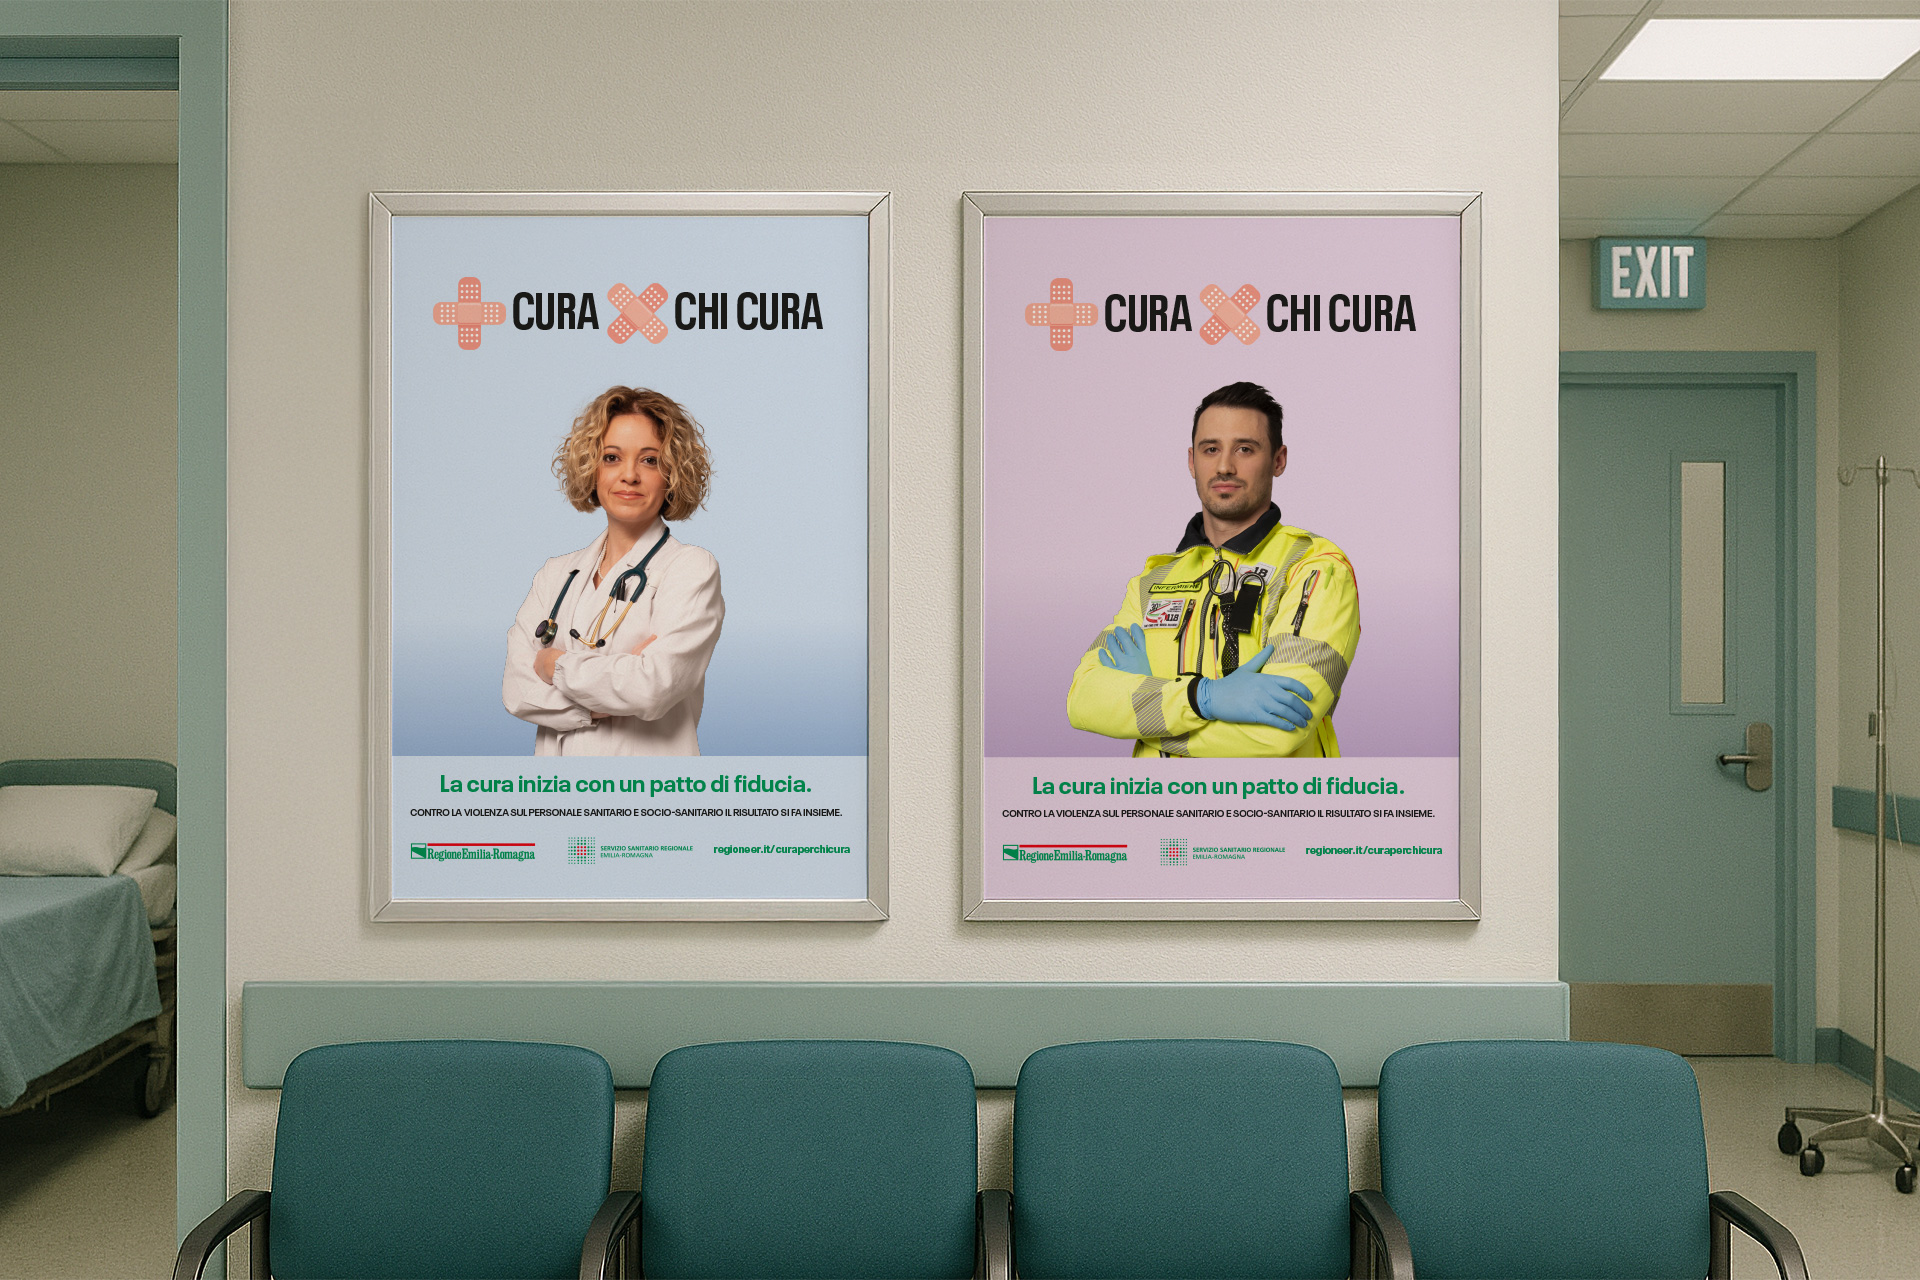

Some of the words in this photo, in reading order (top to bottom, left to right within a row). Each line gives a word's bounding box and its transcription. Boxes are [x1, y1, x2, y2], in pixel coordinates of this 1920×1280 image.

[1611, 245, 1695, 298] EXIT
[513, 292, 599, 330] CURA
[675, 292, 728, 330] CHI
[737, 292, 823, 330] CURA
[1105, 294, 1192, 332] CURA
[1267, 294, 1320, 332] CHI
[1329, 294, 1416, 332] CURA
[441, 775, 462, 792] La
[467, 779, 513, 793] cura
[519, 774, 571, 792] inizia
[576, 779, 615, 793] con
[620, 779, 645, 793] un
[650, 776, 706, 798] patto
[711, 774, 729, 793] di
[734, 774, 812, 793] fiducia.
[1033, 777, 1054, 794] La
[1059, 781, 1105, 795] cura
[1110, 776, 1163, 794] inizia
[1168, 781, 1207, 795] con
[1212, 781, 1237, 795] un
[1242, 778, 1298, 800] patto
[1303, 776, 1321, 795] di
[1326, 776, 1405, 795] fiducia.
[410, 809, 450, 817] CONTRO
[451, 809, 462, 817] LA
[463, 809, 509, 817] VIOLENZA
[510, 809, 528, 817] SUL
[529, 809, 582, 817] PERSONALE
[584, 809, 632, 817] SANITARIO
[634, 809, 640, 817] E
[641, 809, 723, 817] SOCIO-SANITARIO
[725, 809, 732, 817] IL
[733, 809, 779, 817] RISULTATO
[781, 809, 790, 817] SI
[791, 809, 802, 817] FA
[803, 809, 843, 817] INSIEME.
[1002, 810, 1042, 818] CONTRO
[1044, 810, 1055, 818] LA
[1056, 810, 1101, 818] VIOLENZA
[1102, 810, 1119, 818] SUL
[1121, 810, 1174, 818] PERSONALE
[1176, 810, 1224, 818] SANITARIO
[1226, 810, 1232, 818] E
[1233, 810, 1316, 818] SOCIO-SANITARIO
[1318, 810, 1325, 818] IL
[1326, 810, 1371, 818] RISULTATO
[1373, 810, 1382, 818] SI
[1384, 810, 1394, 818] FA
[1396, 810, 1435, 818] INSIEME.
[1305, 846, 1443, 857] regioneer.it/curaperchicura
